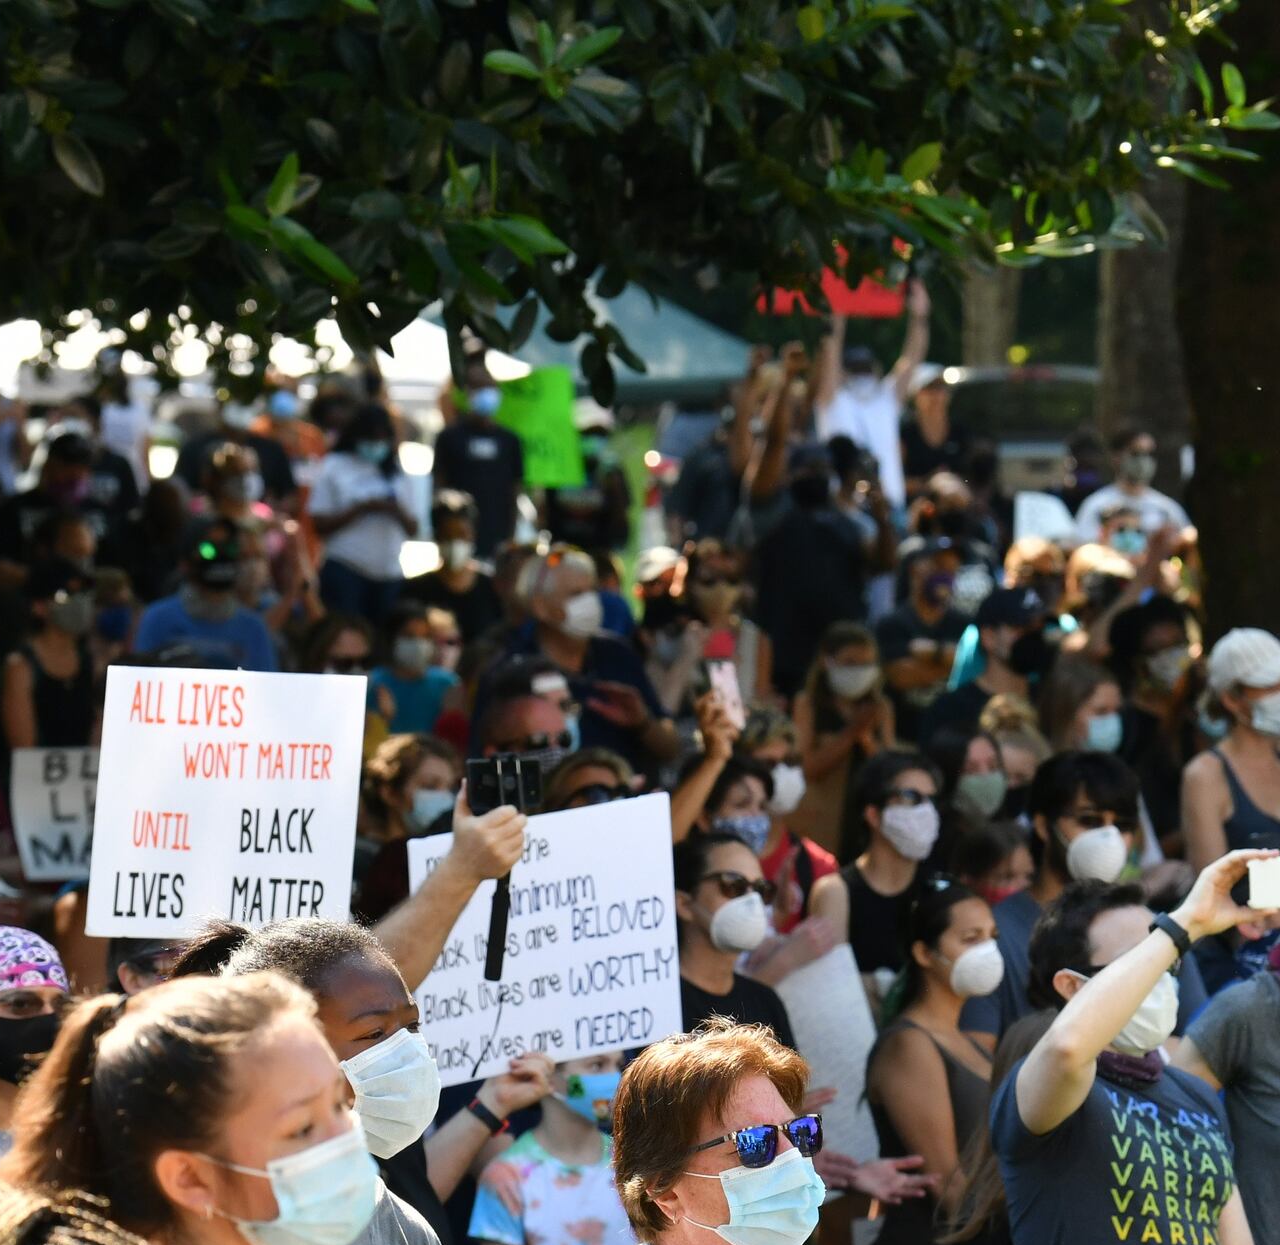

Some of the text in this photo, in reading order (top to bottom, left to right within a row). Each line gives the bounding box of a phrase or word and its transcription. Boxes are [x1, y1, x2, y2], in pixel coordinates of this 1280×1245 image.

[130, 681, 245, 728] ALL LIVES
[183, 742, 333, 780] WON'T MATTER
[132, 808, 314, 853] UNTIL BLACK
[113, 871, 324, 922] LIVES MATTER
[509, 874, 596, 919] inimum
[525, 923, 558, 950] are
[572, 896, 665, 942] BELOVED
[423, 946, 677, 1025] Black lives are WORTHY
[480, 1033, 524, 1064] lives
[530, 1027, 564, 1055] are
